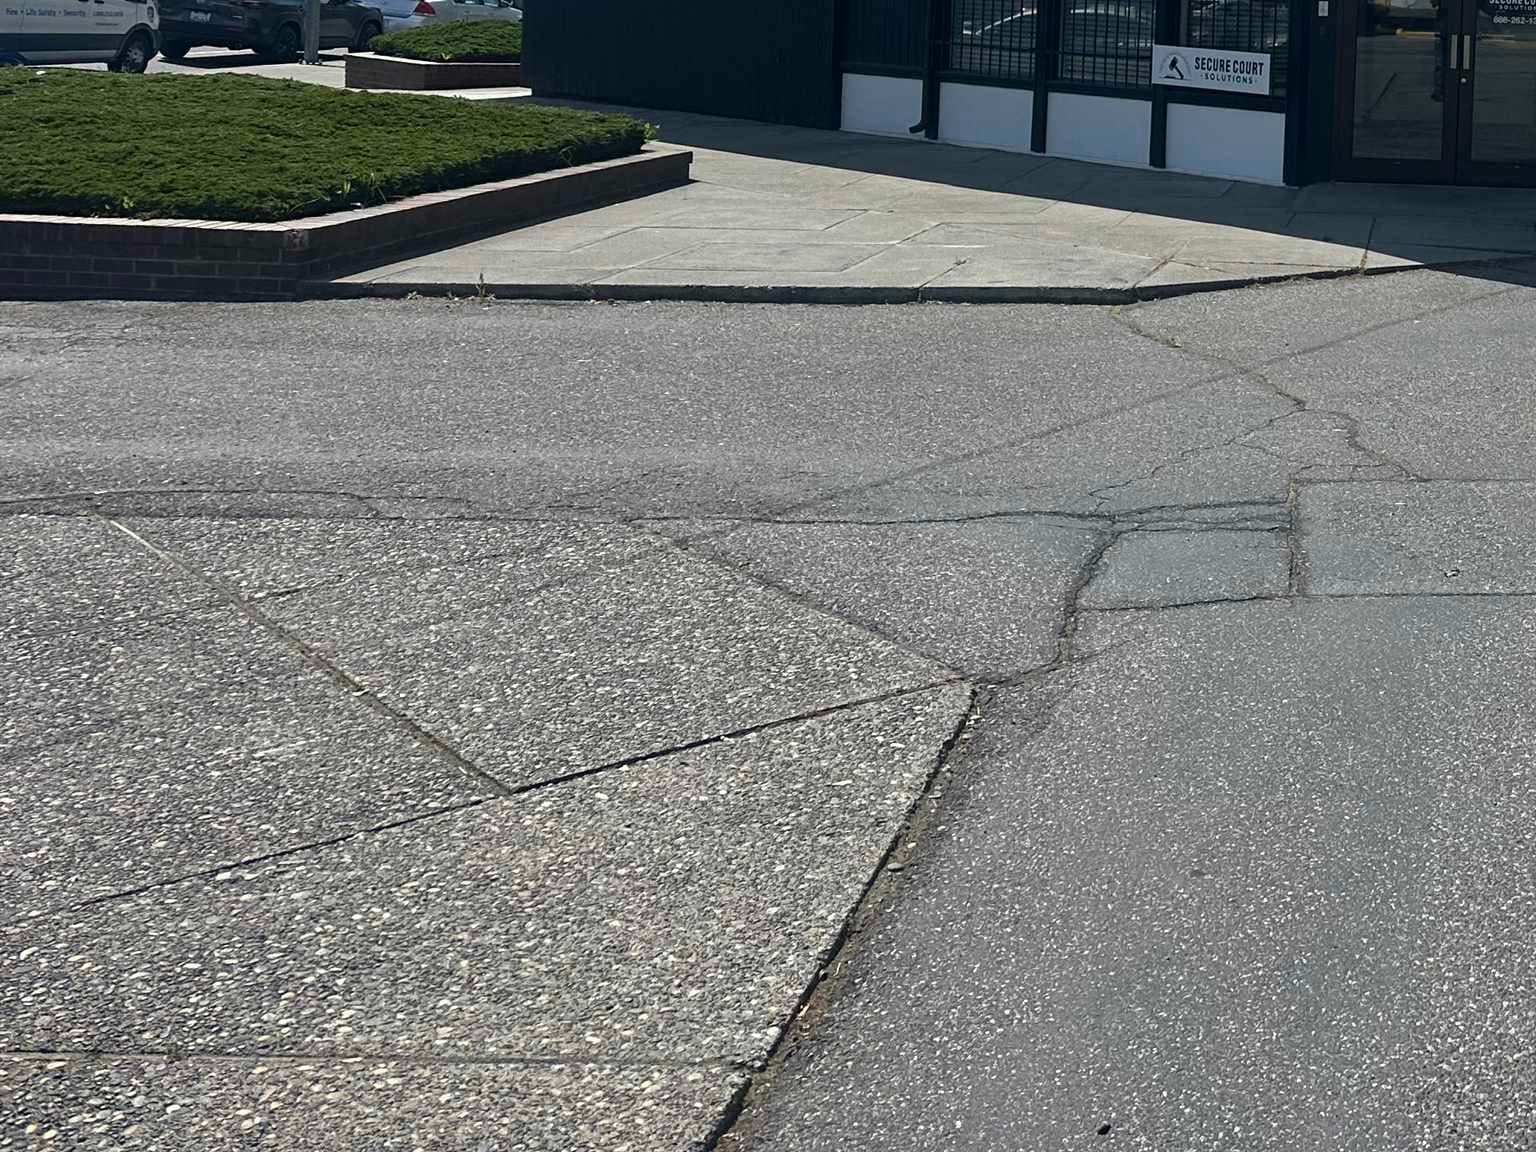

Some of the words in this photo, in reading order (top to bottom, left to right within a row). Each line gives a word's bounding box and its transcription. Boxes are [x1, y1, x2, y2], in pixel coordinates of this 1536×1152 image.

[1194, 57, 1231, 73] SECURE
[1232, 60, 1264, 76] COURT
[1204, 73, 1253, 84] SOLUTIONS
